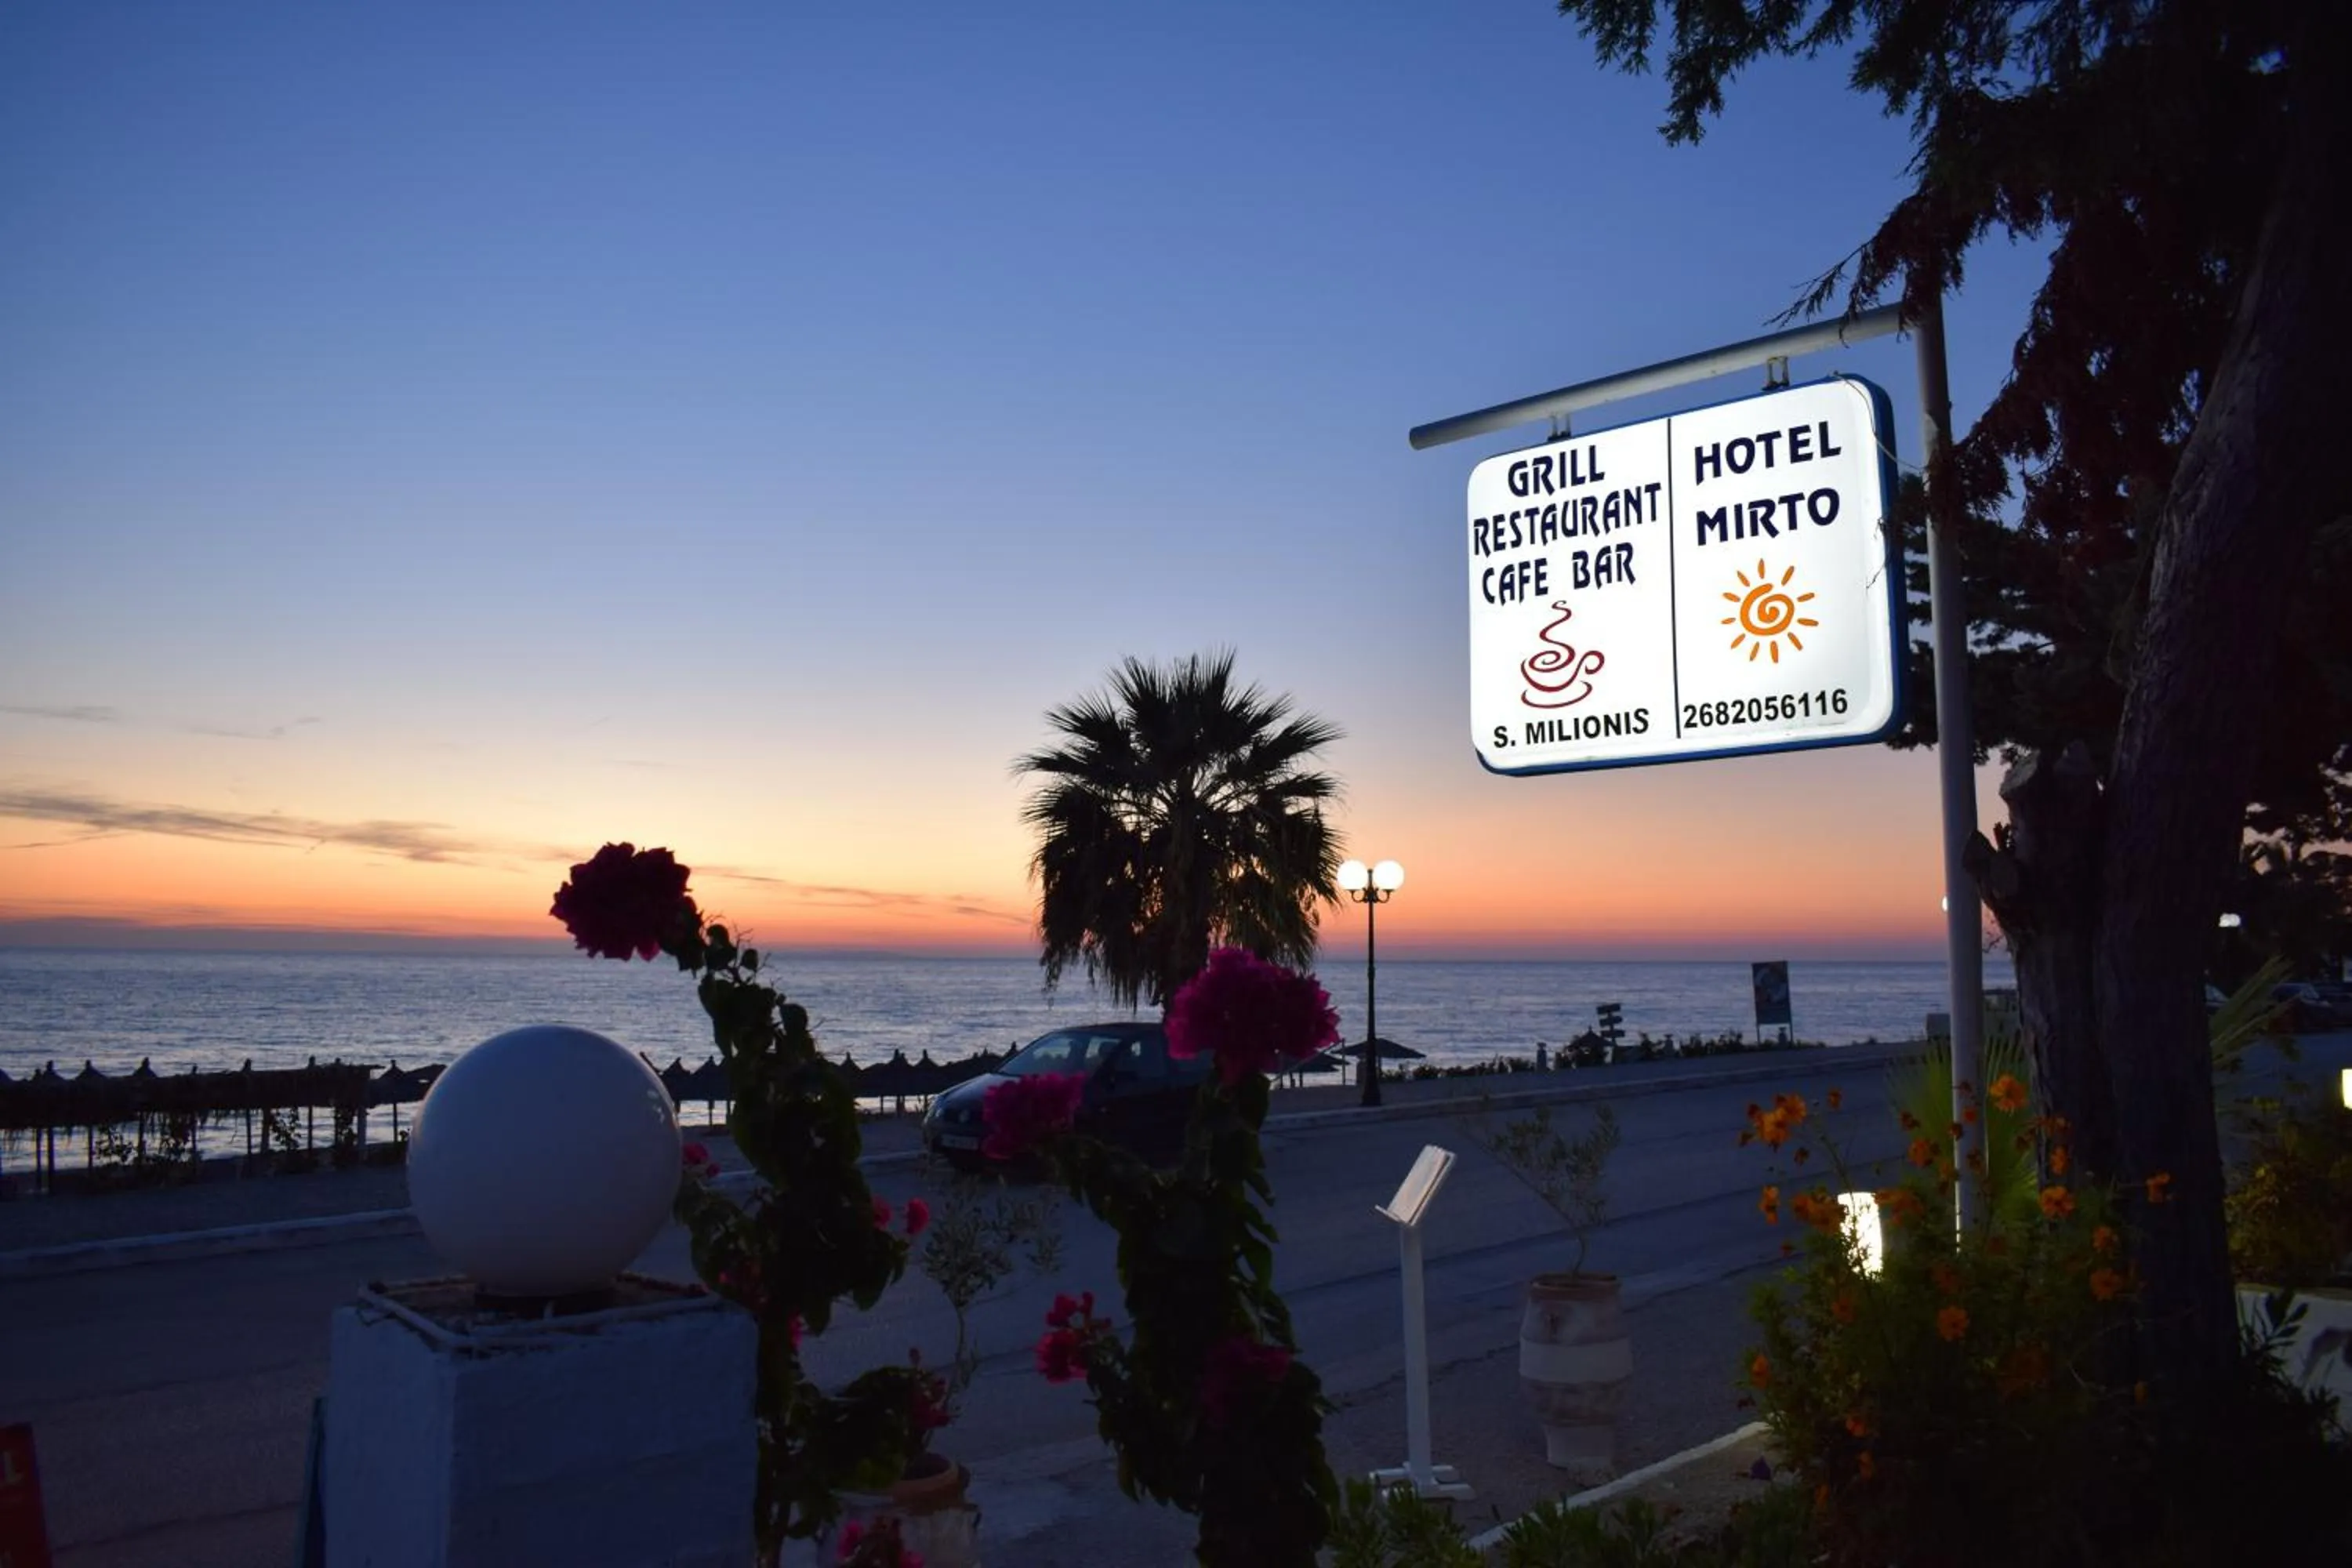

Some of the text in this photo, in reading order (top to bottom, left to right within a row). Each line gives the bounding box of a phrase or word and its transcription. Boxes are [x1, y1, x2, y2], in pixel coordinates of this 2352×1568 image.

[1508, 445, 1606, 498] GRILL
[1694, 420, 1842, 486] HOTEL
[1473, 482, 1661, 557] RESTAURANT
[1696, 488, 1840, 546] MIRTO
[1482, 542, 1636, 607] CAFE BAR
[1494, 708, 1650, 749] S. MILIONIS
[1683, 688, 1848, 729] 2682056116
